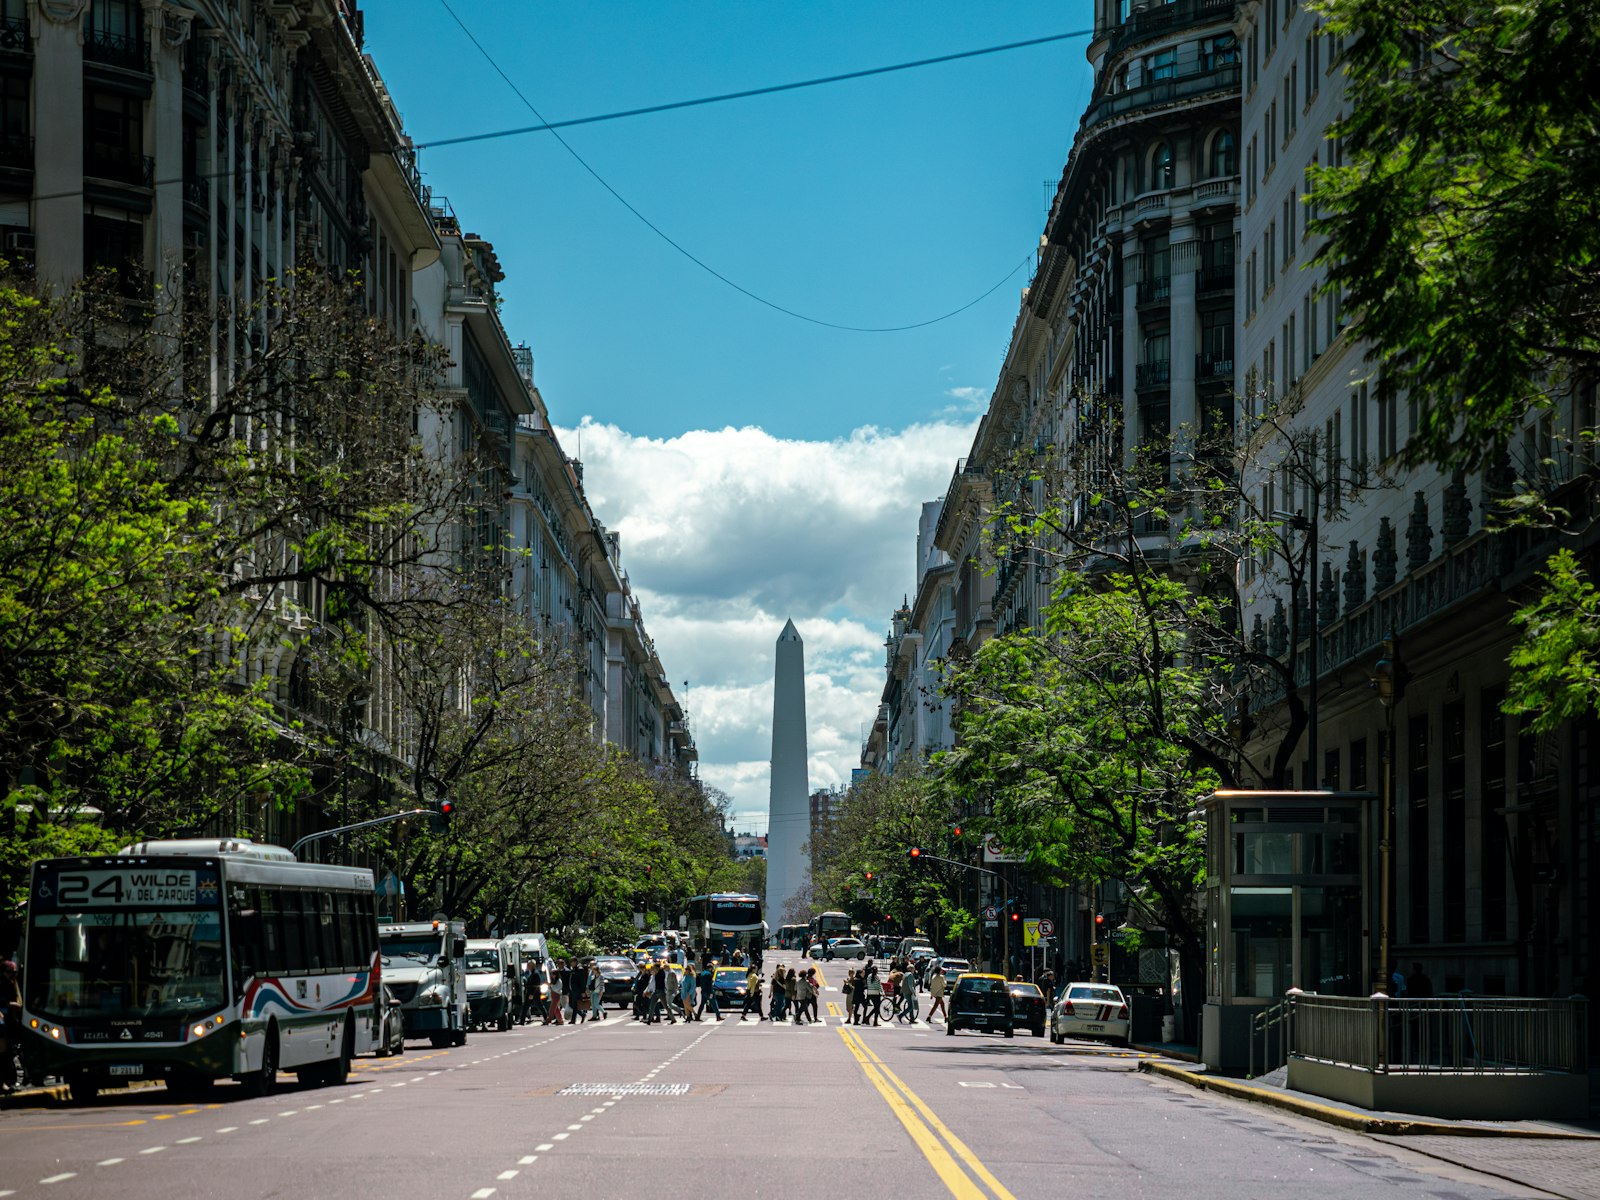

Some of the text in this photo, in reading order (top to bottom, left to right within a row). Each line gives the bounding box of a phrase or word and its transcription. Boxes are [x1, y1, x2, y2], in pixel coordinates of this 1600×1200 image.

[130, 874, 191, 887] WILDE
[58, 875, 124, 904] 24
[125, 888, 195, 902] V. DEL PARQUE
